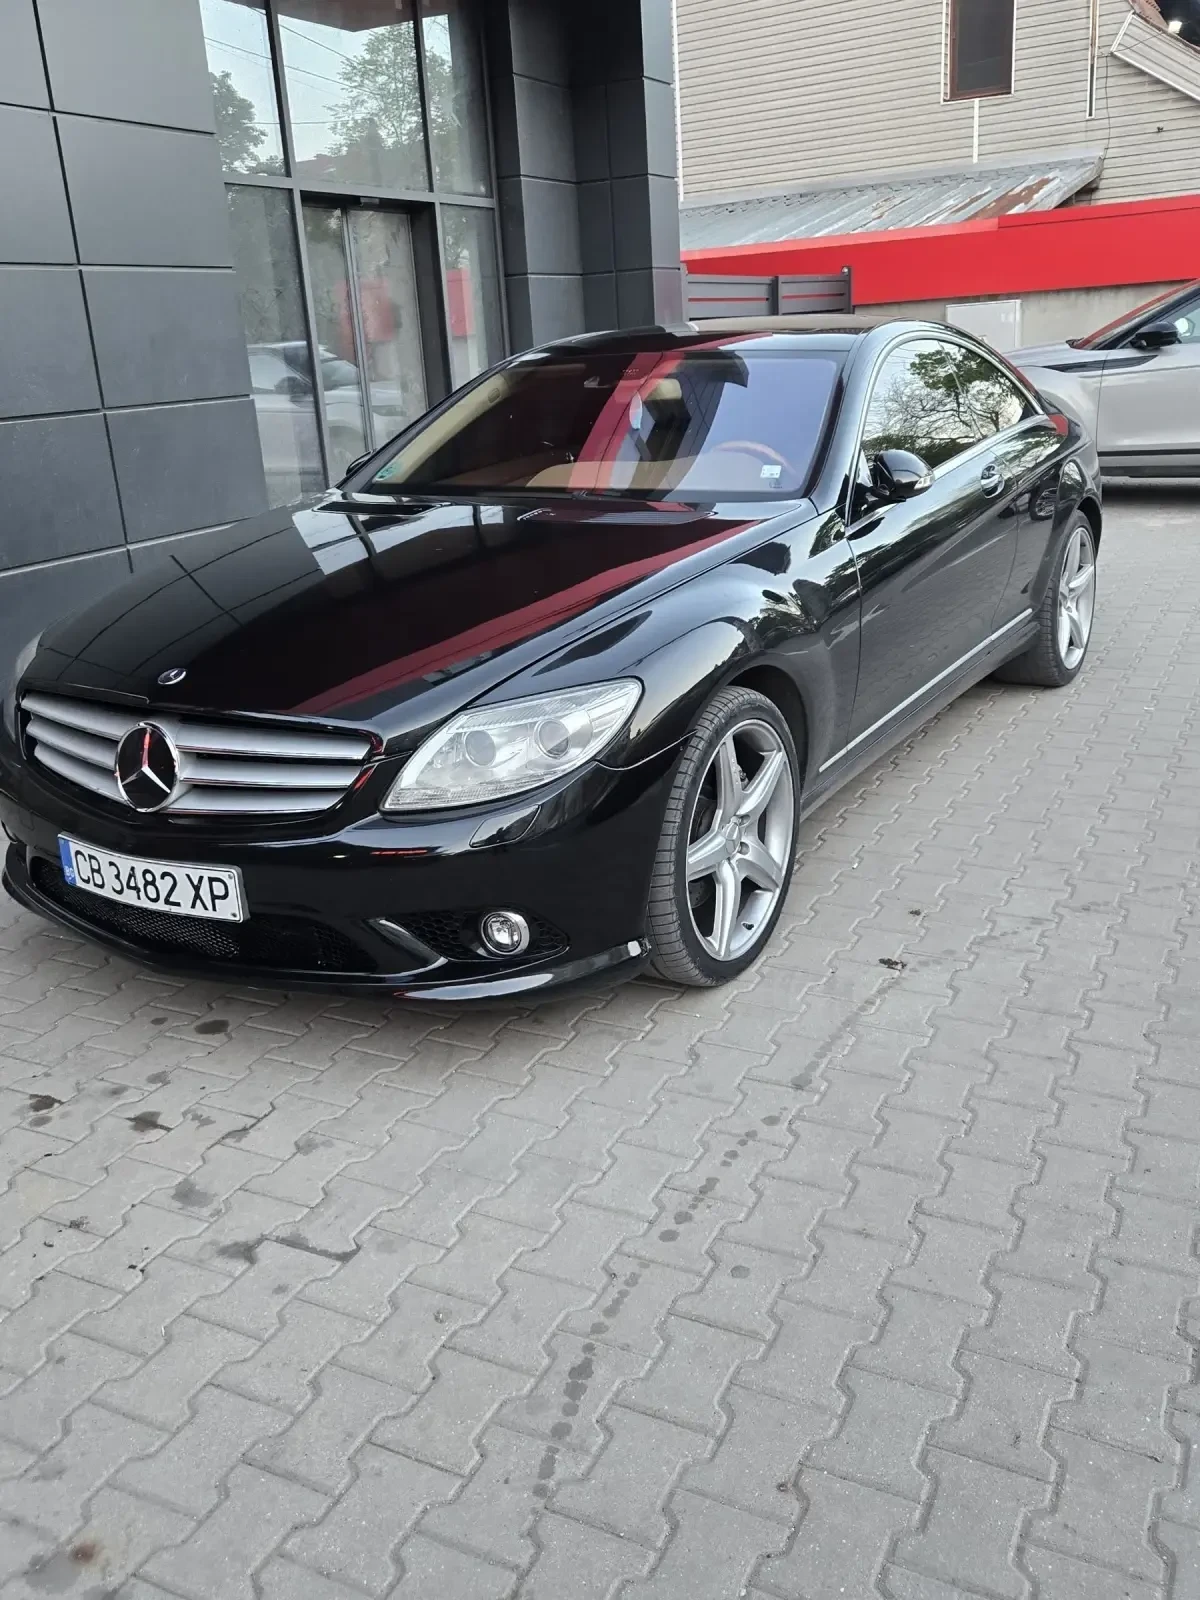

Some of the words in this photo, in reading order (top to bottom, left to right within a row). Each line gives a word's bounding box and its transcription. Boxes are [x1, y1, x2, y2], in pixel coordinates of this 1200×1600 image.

[64, 865, 75, 879] BG
[74, 849, 106, 890] CB
[108, 860, 182, 908] 3482
[185, 873, 230, 912] XP
